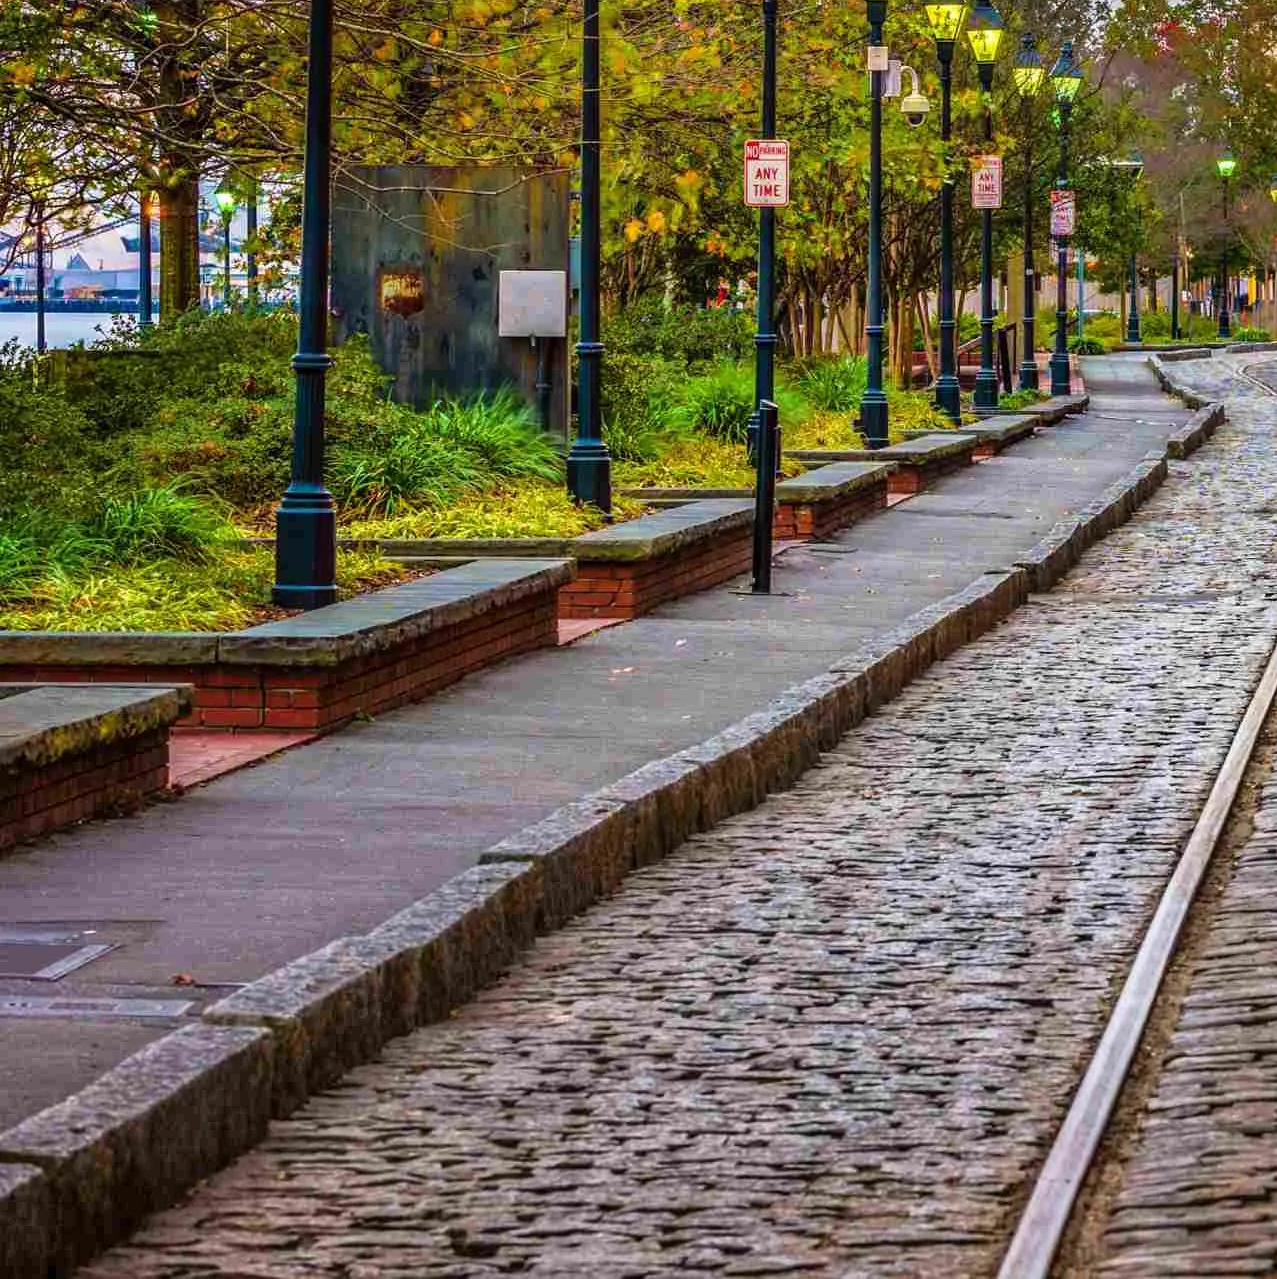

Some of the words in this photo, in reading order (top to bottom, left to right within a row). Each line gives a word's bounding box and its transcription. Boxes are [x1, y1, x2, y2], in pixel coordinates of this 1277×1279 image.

[747, 146, 759, 158] NO
[759, 147, 786, 155] PARKING
[755, 168, 778, 179] ANY
[753, 184, 782, 197] TIME
